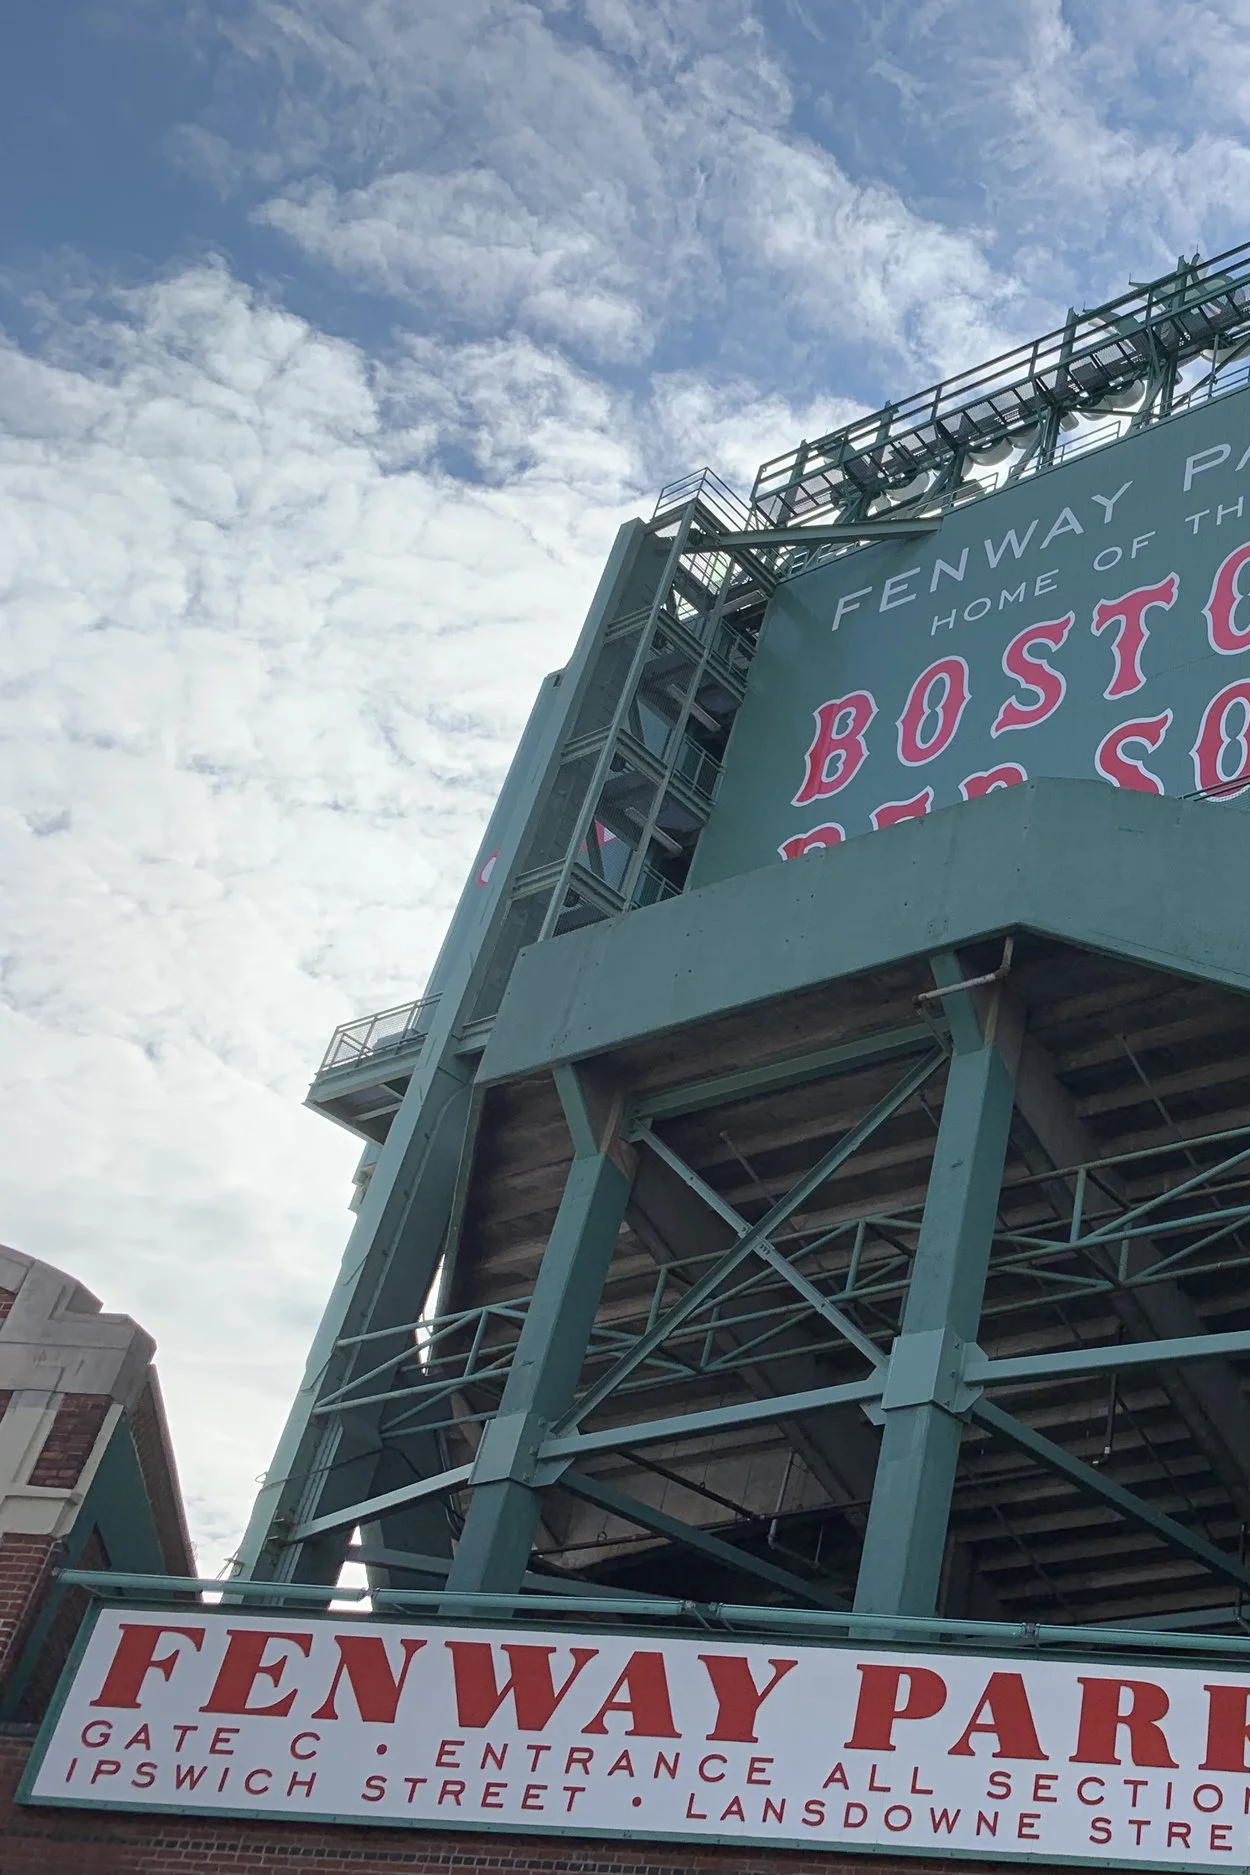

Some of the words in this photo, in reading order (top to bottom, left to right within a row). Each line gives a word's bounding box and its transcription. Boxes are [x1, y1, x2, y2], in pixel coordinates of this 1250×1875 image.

[832, 480, 1134, 631] FENWAY
[930, 570, 1058, 636] HOME
[1093, 531, 1156, 572] OF
[90, 1622, 798, 1743] FENWAY
[65, 1757, 317, 1797] IPSWICH
[361, 1775, 585, 1812] STREET
[686, 1793, 1041, 1840] LANSDOWNE
[80, 1719, 240, 1756] GATE
[290, 1732, 321, 1760] C
[435, 1739, 775, 1786] ENTRANCE
[822, 1762, 934, 1795] ALL
